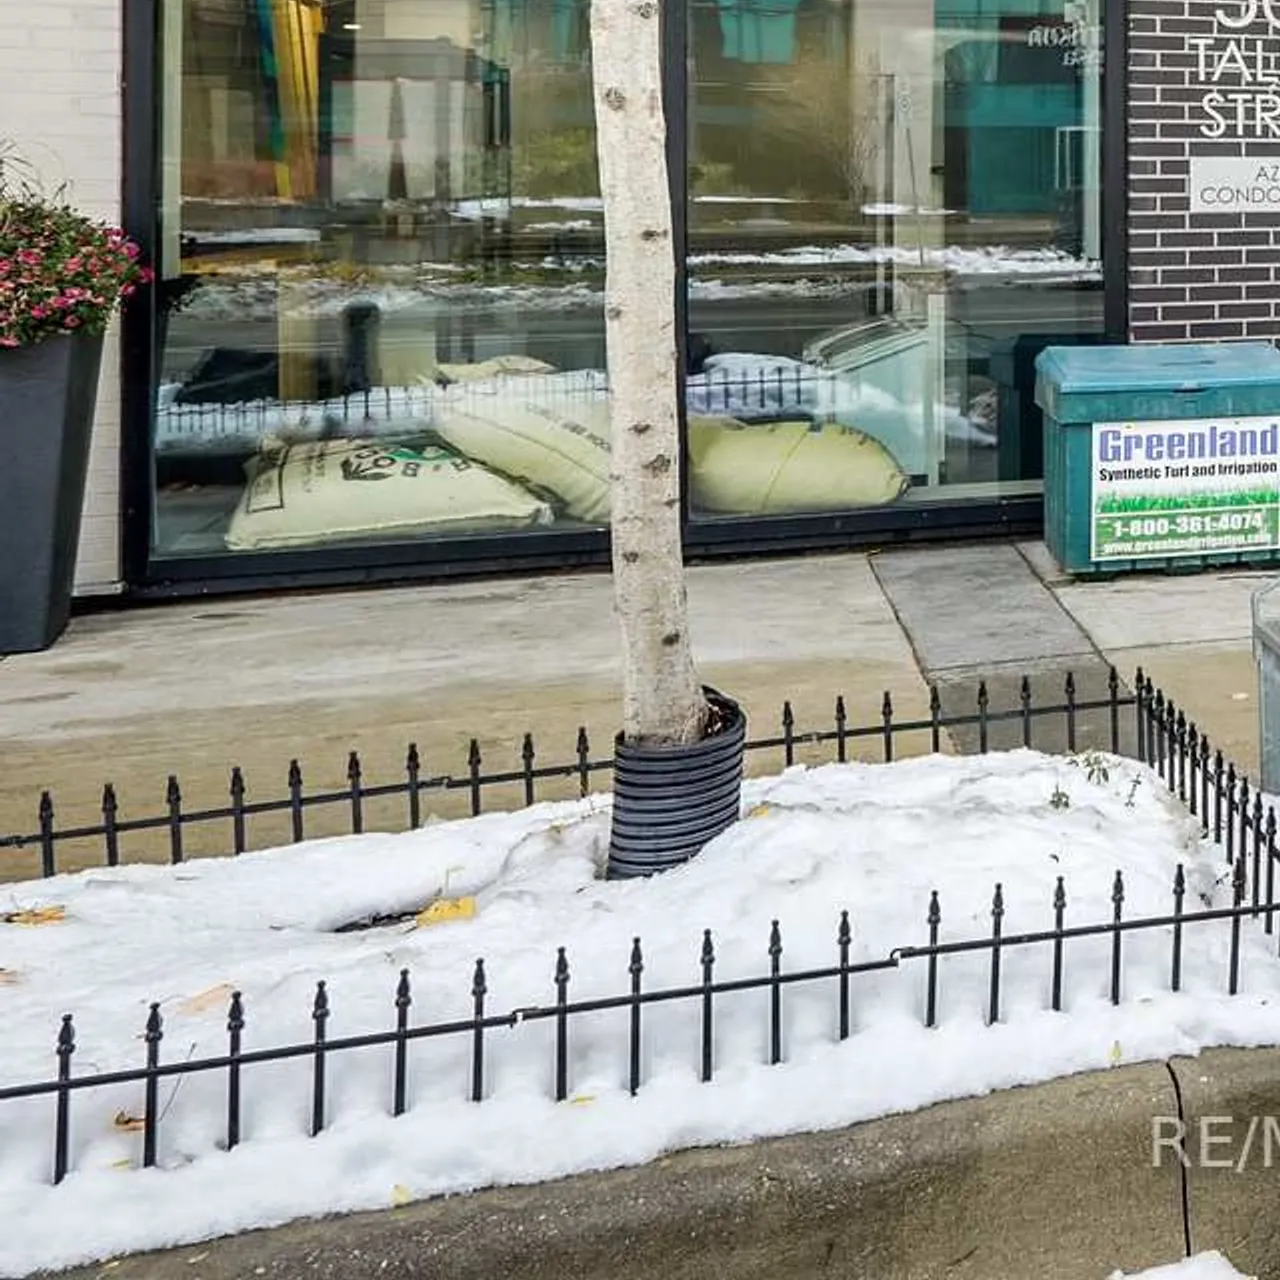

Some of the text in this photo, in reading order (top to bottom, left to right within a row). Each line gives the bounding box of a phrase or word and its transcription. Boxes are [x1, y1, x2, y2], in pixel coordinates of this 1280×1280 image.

[1099, 424, 1279, 463] Greenland
[1099, 461, 1278, 482] Synthetic Turf and Irrigation
